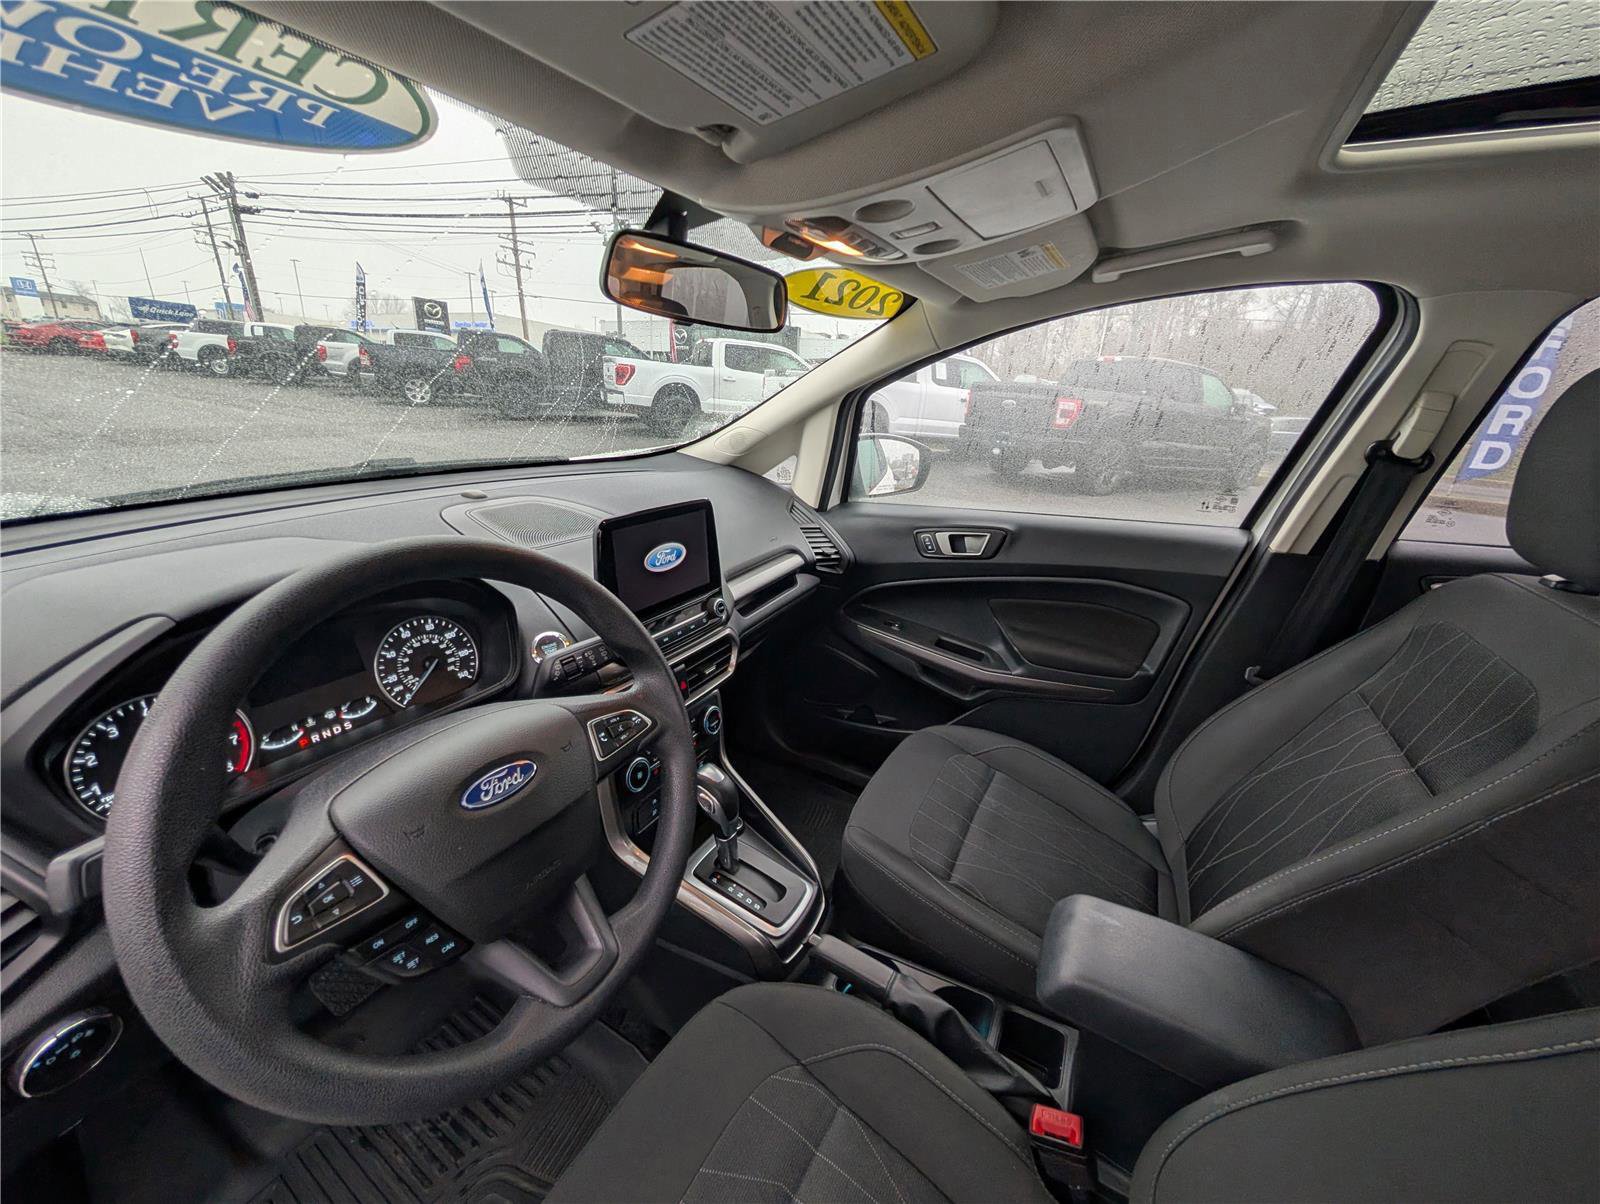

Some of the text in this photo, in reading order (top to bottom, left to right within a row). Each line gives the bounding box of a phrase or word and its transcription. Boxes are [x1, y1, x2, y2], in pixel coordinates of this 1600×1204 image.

[655, 548, 677, 566] Ford
[105, 725, 120, 740] 3
[84, 754, 98, 767] 2
[480, 767, 525, 801] Ford
[372, 938, 385, 949] ON
